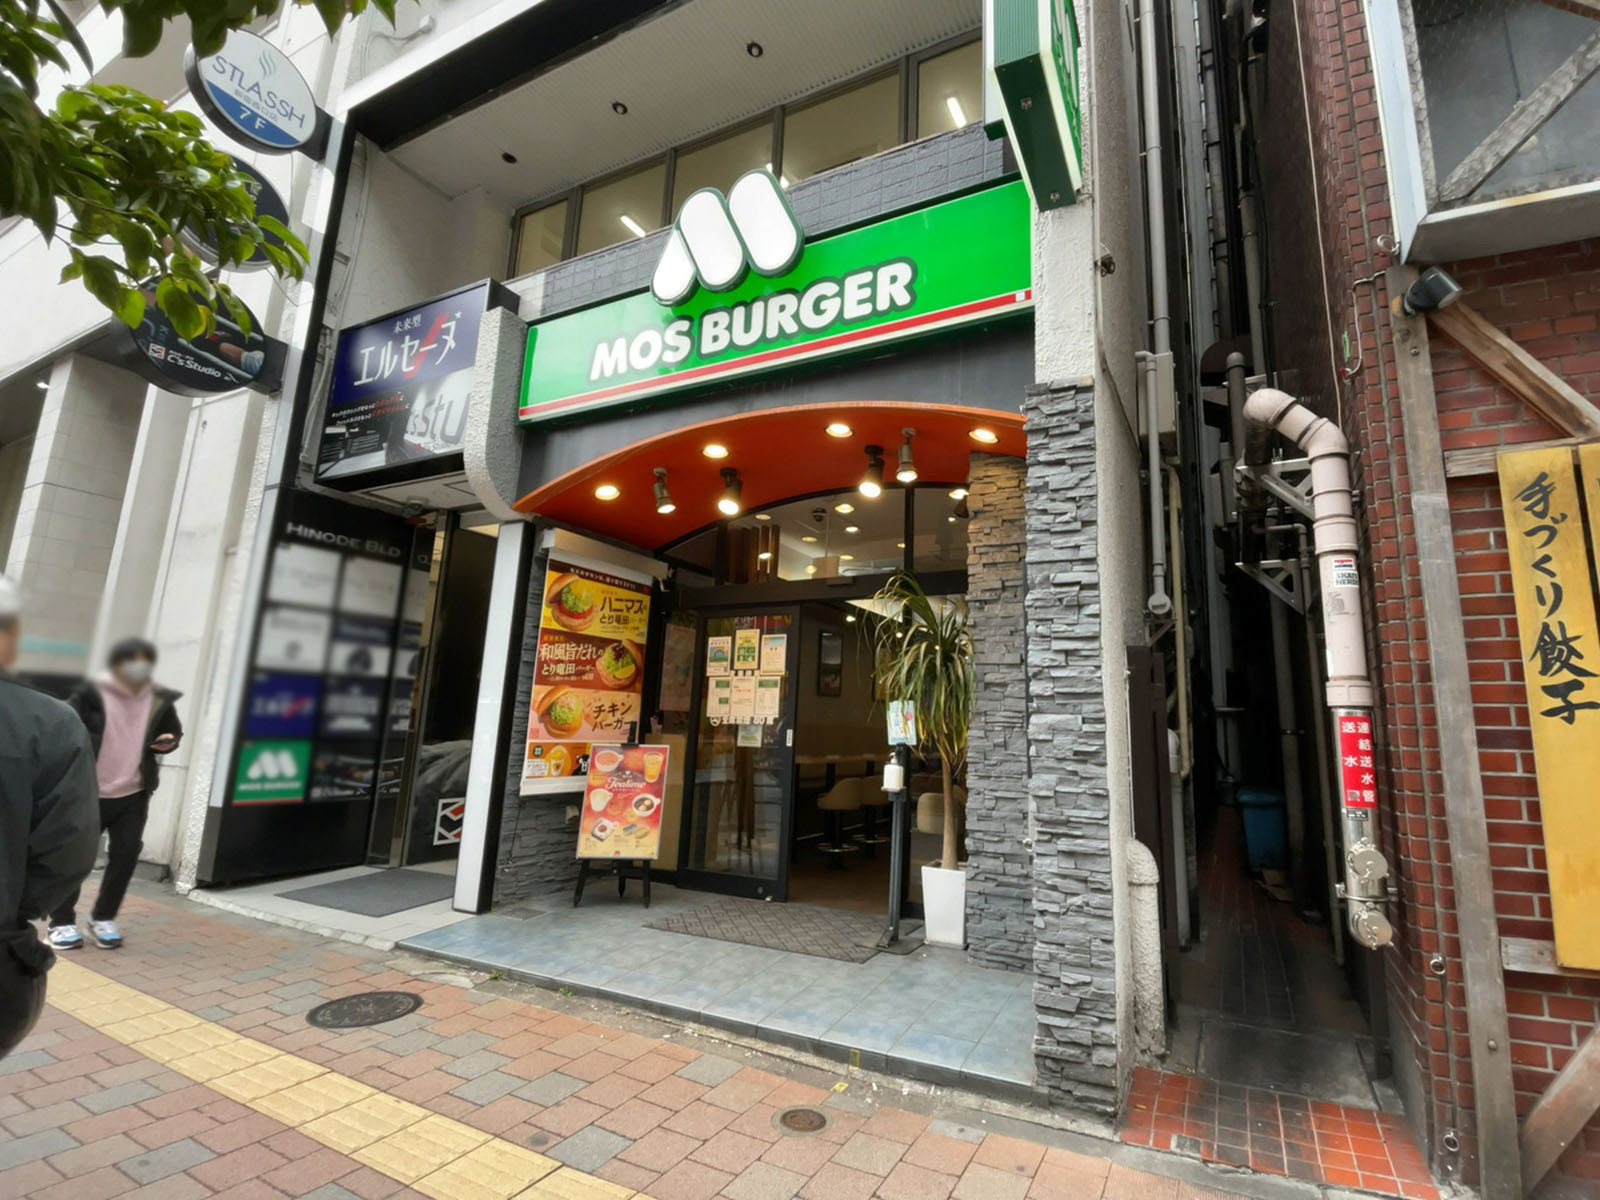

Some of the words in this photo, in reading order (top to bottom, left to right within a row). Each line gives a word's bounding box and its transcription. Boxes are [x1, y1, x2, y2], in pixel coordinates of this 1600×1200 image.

[212, 55, 305, 128] STLASSH
[590, 320, 692, 381] MOS
[700, 262, 912, 355] BURGER
[286, 522, 361, 549] HINODE
[364, 540, 401, 558] BLD
[1513, 472, 1600, 725] 手づくり餃子
[592, 717, 637, 732] バーガー
[593, 701, 632, 719] チキン
[1357, 721, 1376, 803] 連結送水管
